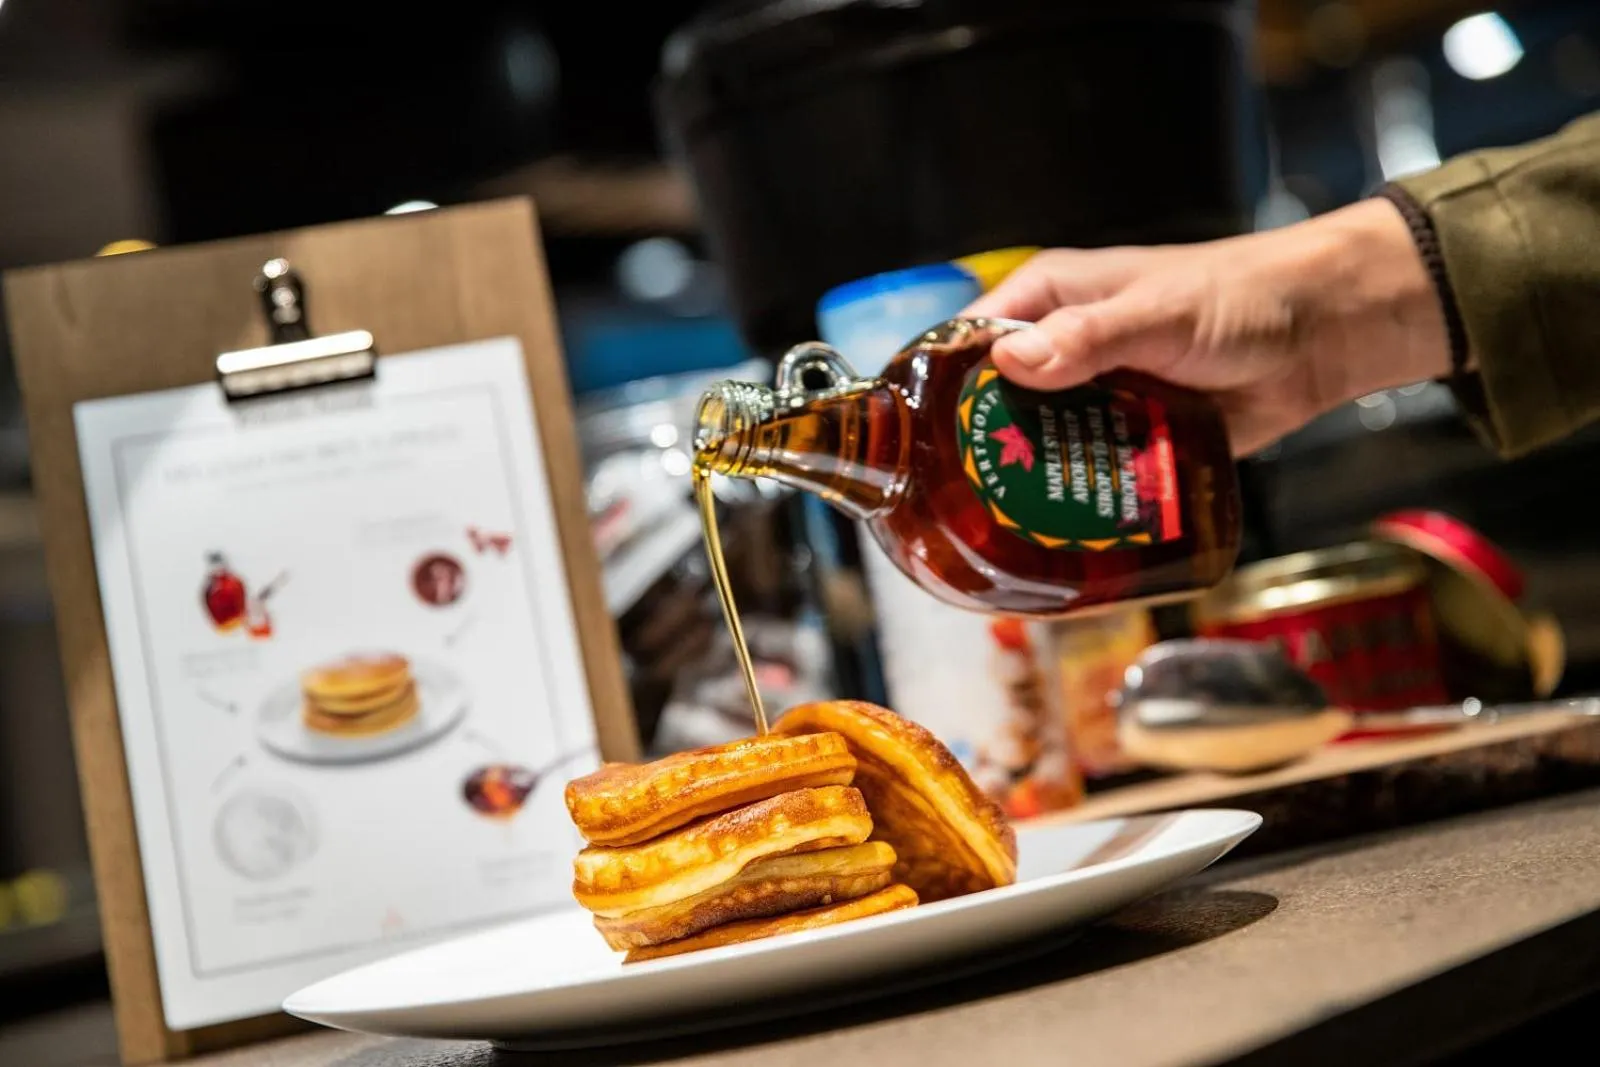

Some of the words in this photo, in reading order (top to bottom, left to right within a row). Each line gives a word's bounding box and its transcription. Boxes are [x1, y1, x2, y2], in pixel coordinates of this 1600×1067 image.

[972, 389, 1006, 499] VERTMONT
[1039, 404, 1059, 449] SYRUP
[1045, 451, 1064, 502] MAPLE
[1095, 472, 1115, 519] SIROP
